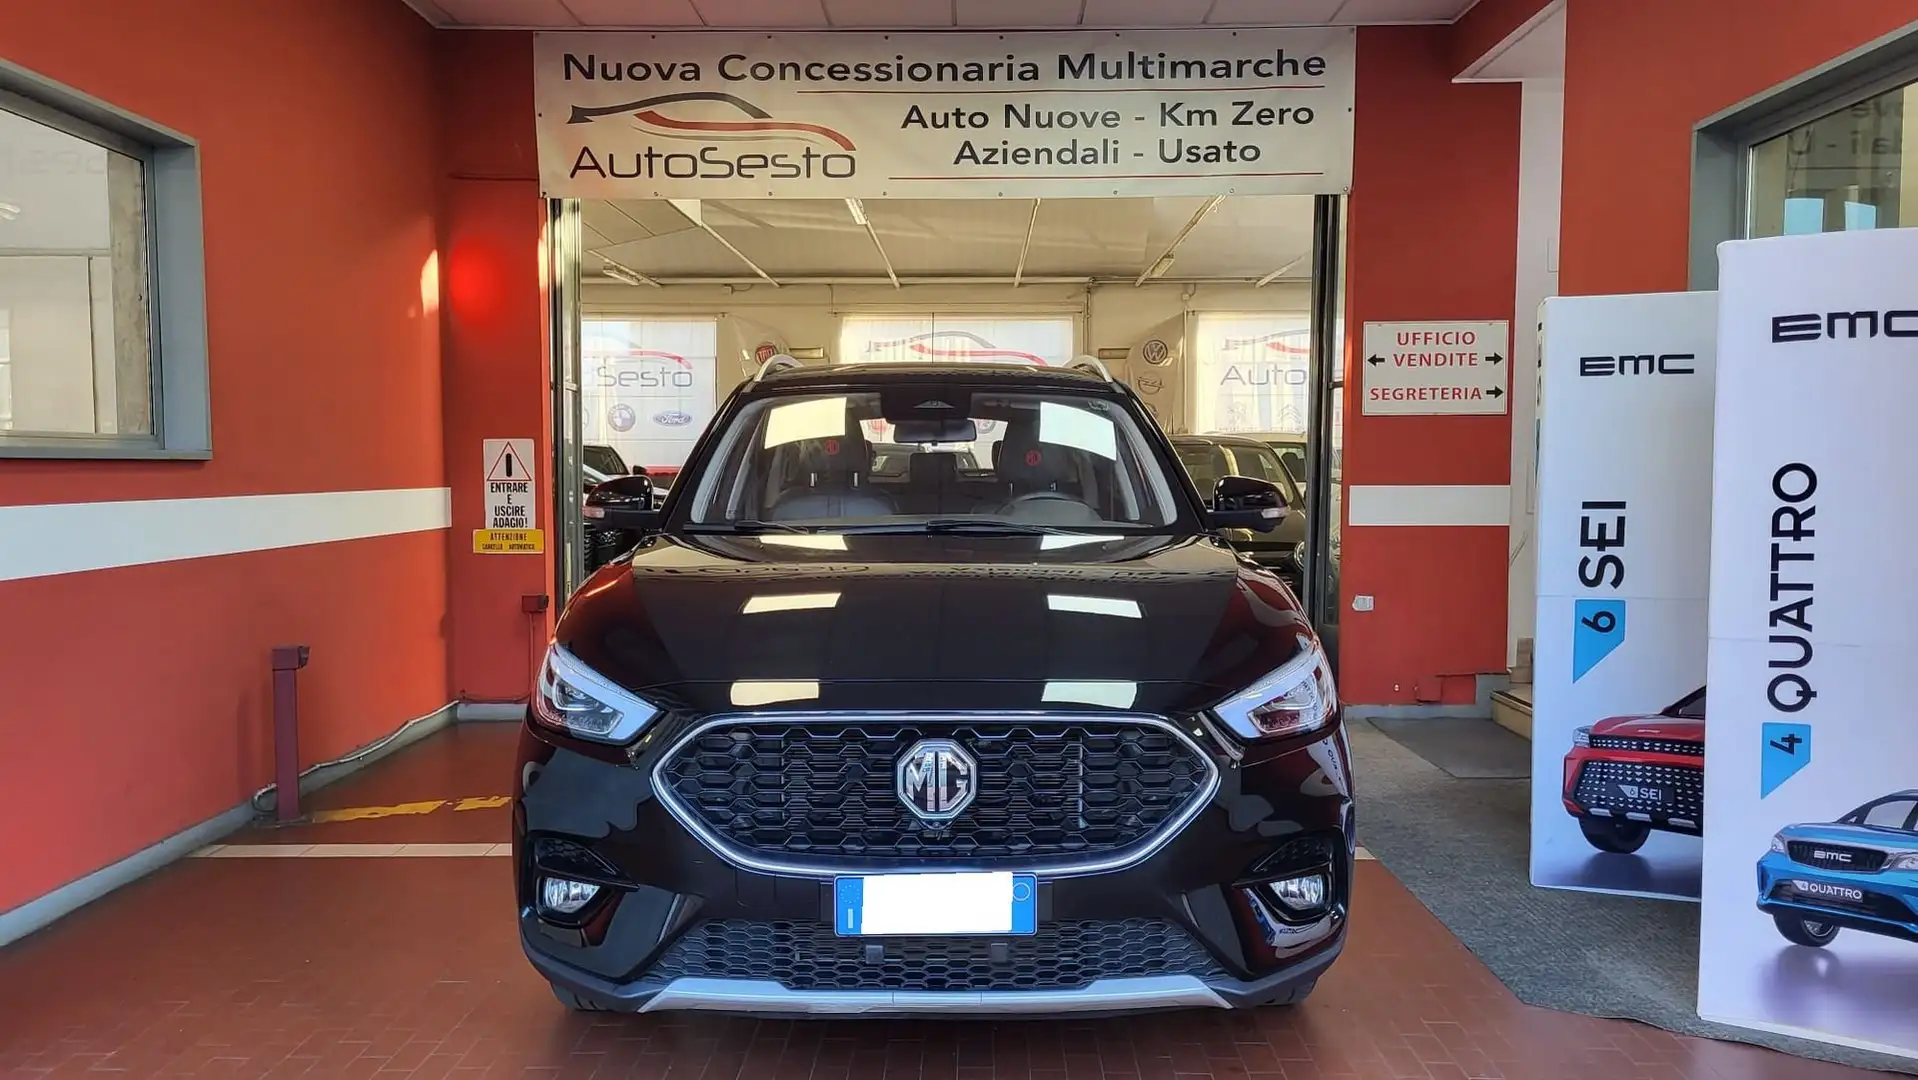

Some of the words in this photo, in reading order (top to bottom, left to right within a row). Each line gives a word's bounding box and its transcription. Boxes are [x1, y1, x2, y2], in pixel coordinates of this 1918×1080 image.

[563, 53, 701, 82] Nuova
[717, 53, 1039, 82] Concessionaria
[1058, 48, 1326, 80] Multimarche
[900, 104, 990, 129] Auto
[1004, 103, 1121, 129] Nuove
[1160, 102, 1217, 127] Km
[1231, 100, 1314, 126] Zero
[953, 138, 1119, 166] Aziendali
[1159, 138, 1261, 164] Usato
[569, 146, 857, 180] AutoSesto
[1397, 331, 1476, 346] UFFICIO
[1393, 352, 1478, 367] VENDITE
[1370, 387, 1482, 401] SEGRETERIA
[490, 482, 528, 493] ENTRARE
[507, 494, 512, 505] E
[494, 505, 526, 517] USCIRE
[493, 517, 528, 528] ADAGIO!
[1578, 500, 1627, 590] SEI
[1767, 462, 1818, 713] QUATTRO
[1581, 610, 1616, 633] 6
[1769, 733, 1803, 756] 4
[904, 751, 969, 812] MG
[1640, 787, 1661, 801] SEI
[1809, 882, 1862, 900] QUATTRO
